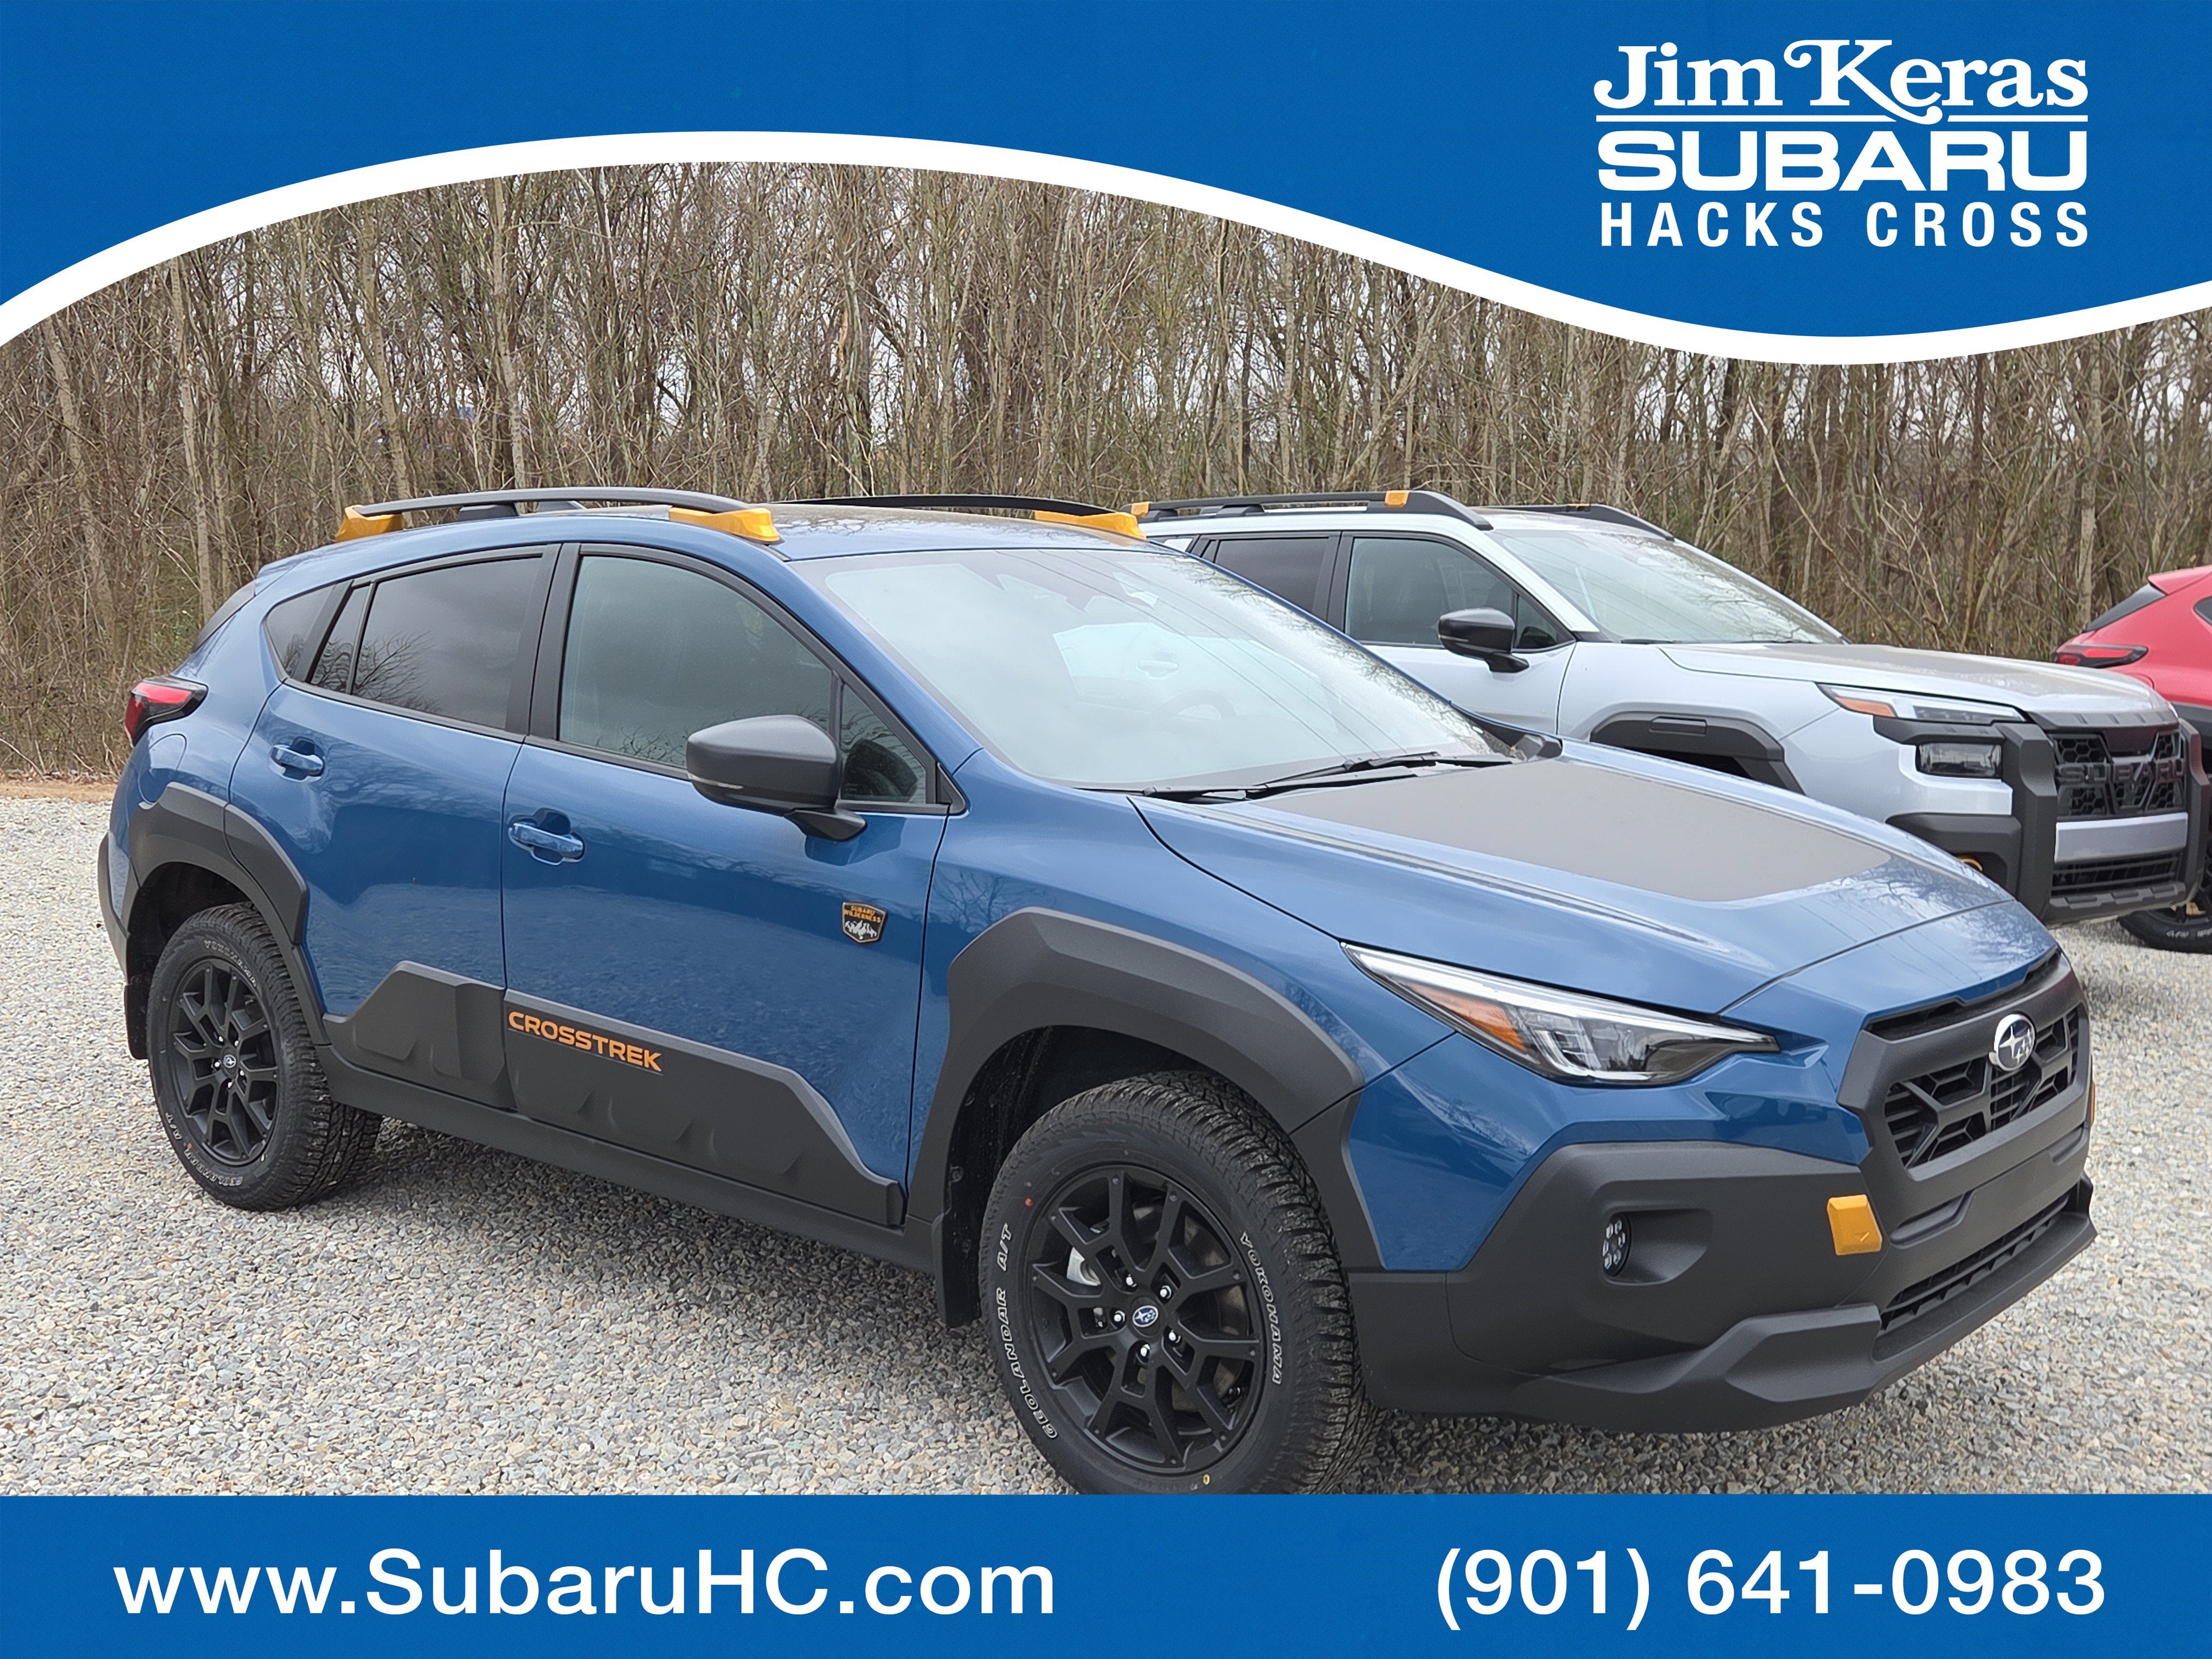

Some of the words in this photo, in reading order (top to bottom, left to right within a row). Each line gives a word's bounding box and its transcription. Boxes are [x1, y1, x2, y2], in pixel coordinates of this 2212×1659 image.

[509, 1011, 661, 1072] CROSSTREK
[996, 1223, 1012, 1271] A/T
[1240, 1231, 1282, 1384] YOKOHAMA
[996, 1287, 1058, 1438] GEOLANDAR
